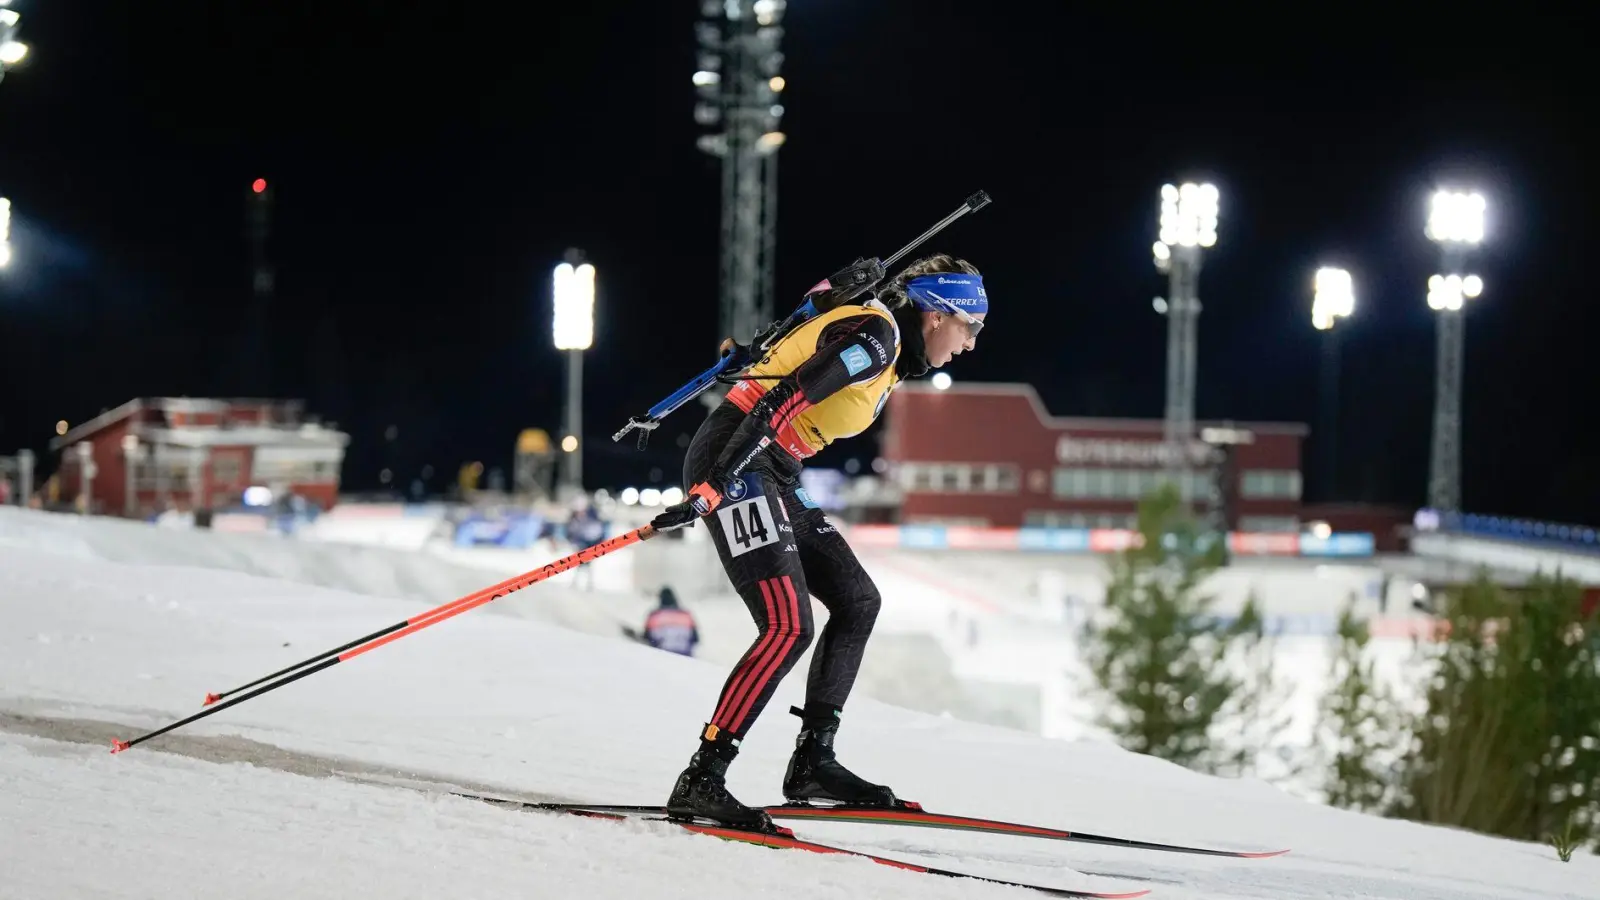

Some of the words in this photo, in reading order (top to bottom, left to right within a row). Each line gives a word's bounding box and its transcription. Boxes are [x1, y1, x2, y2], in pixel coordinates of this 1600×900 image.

[867, 335, 888, 366] TERREX
[733, 445, 762, 476] Kaufland
[731, 501, 769, 549] 44
